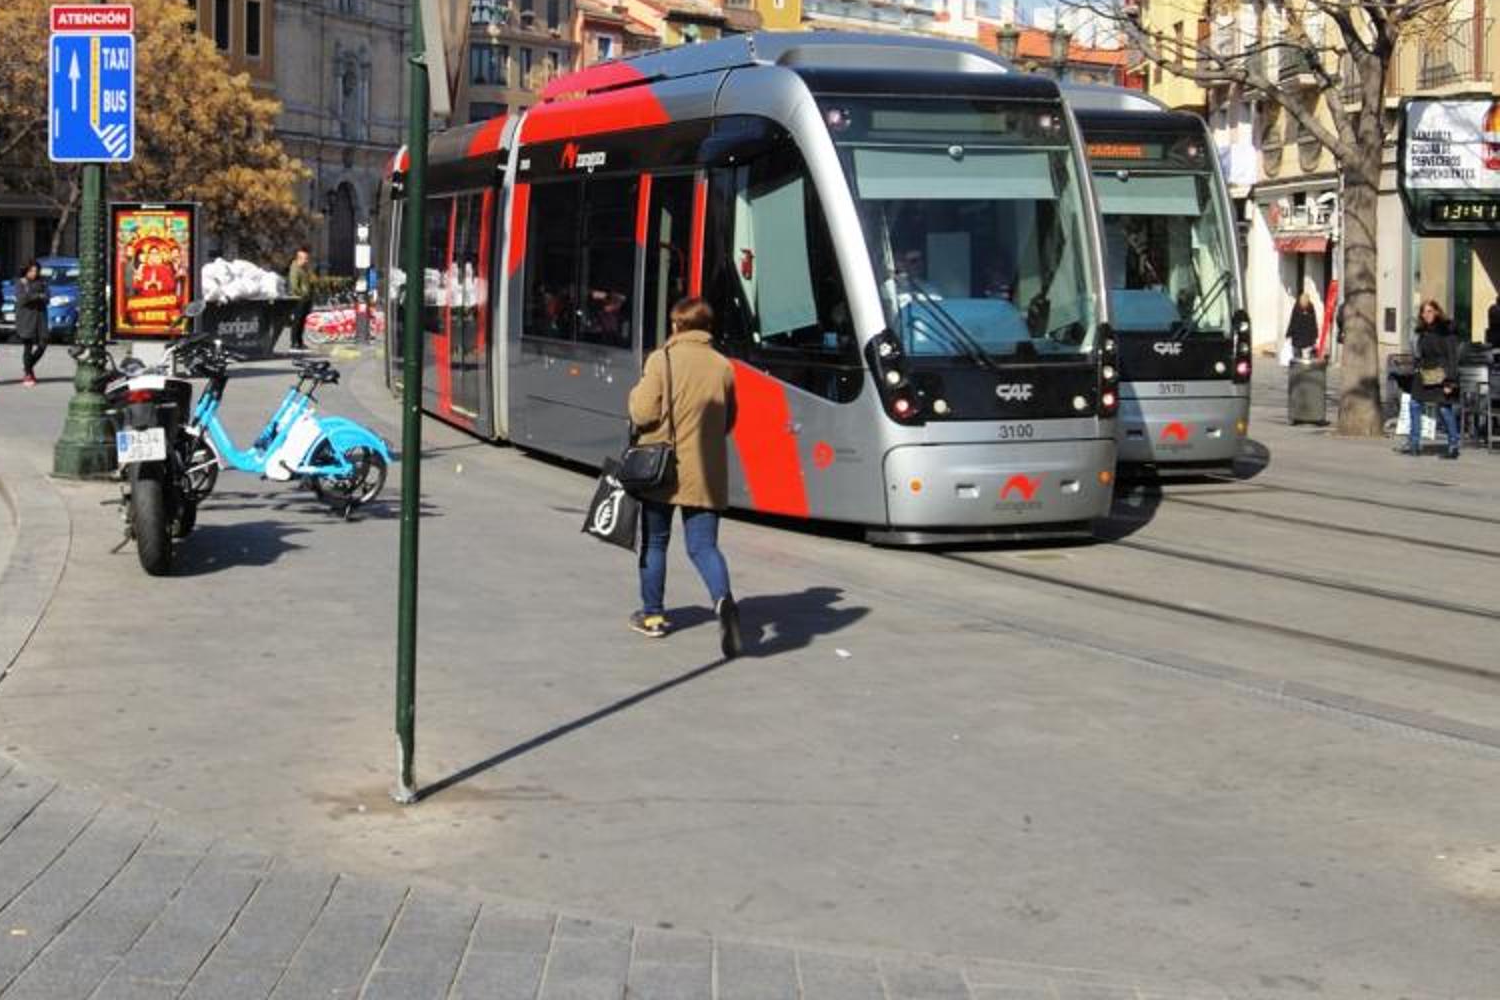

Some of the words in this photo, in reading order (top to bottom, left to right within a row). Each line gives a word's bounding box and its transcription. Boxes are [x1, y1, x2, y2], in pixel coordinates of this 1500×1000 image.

[57, 12, 127, 25] ATENCIÓN
[102, 47, 129, 70] TAXI
[103, 89, 127, 113] BUS
[1443, 205, 1497, 219] 13:41
[996, 383, 1033, 400] CAF
[999, 423, 1033, 438] 3100
